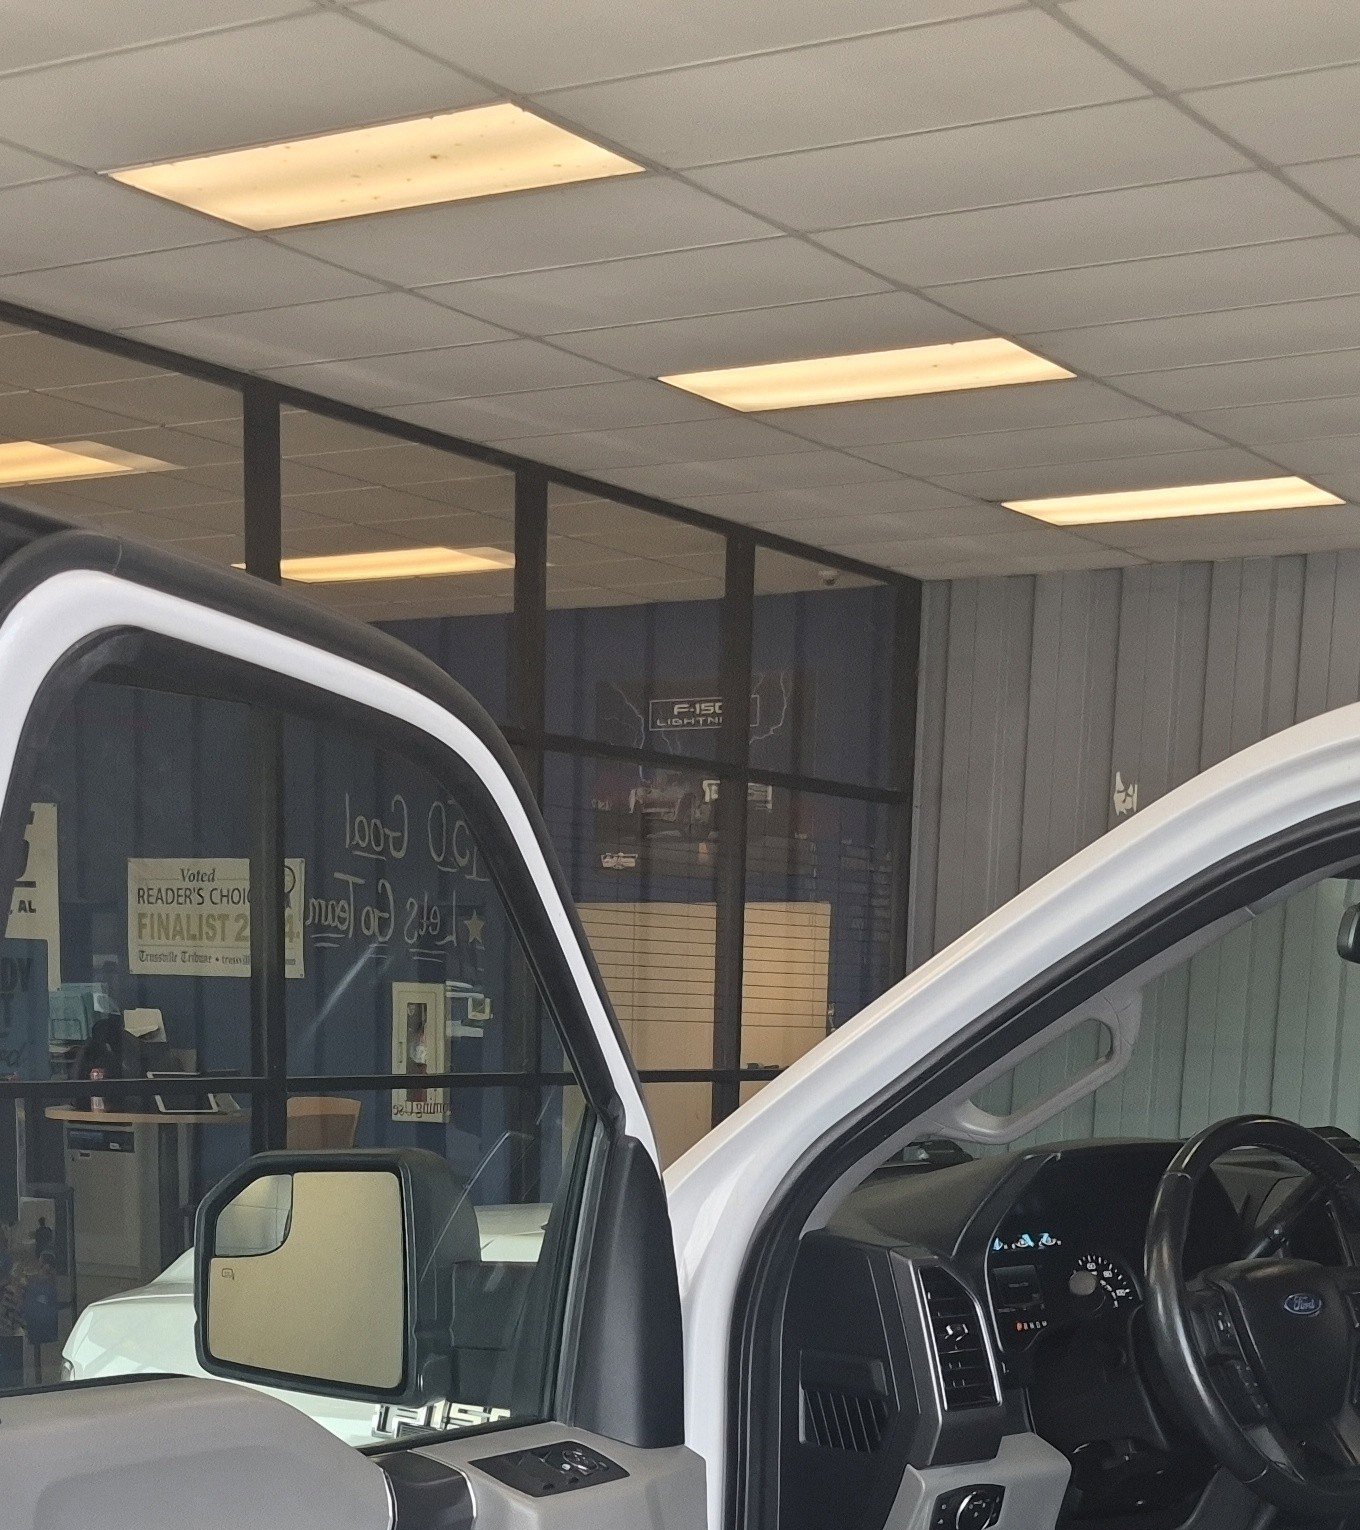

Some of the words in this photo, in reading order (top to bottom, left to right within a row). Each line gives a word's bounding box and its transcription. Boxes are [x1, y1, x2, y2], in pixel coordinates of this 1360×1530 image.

[656, 716, 723, 727] LIGHTNI
[180, 867, 216, 883] Voted
[137, 887, 204, 906] READER'S
[137, 912, 230, 942] FINALIST
